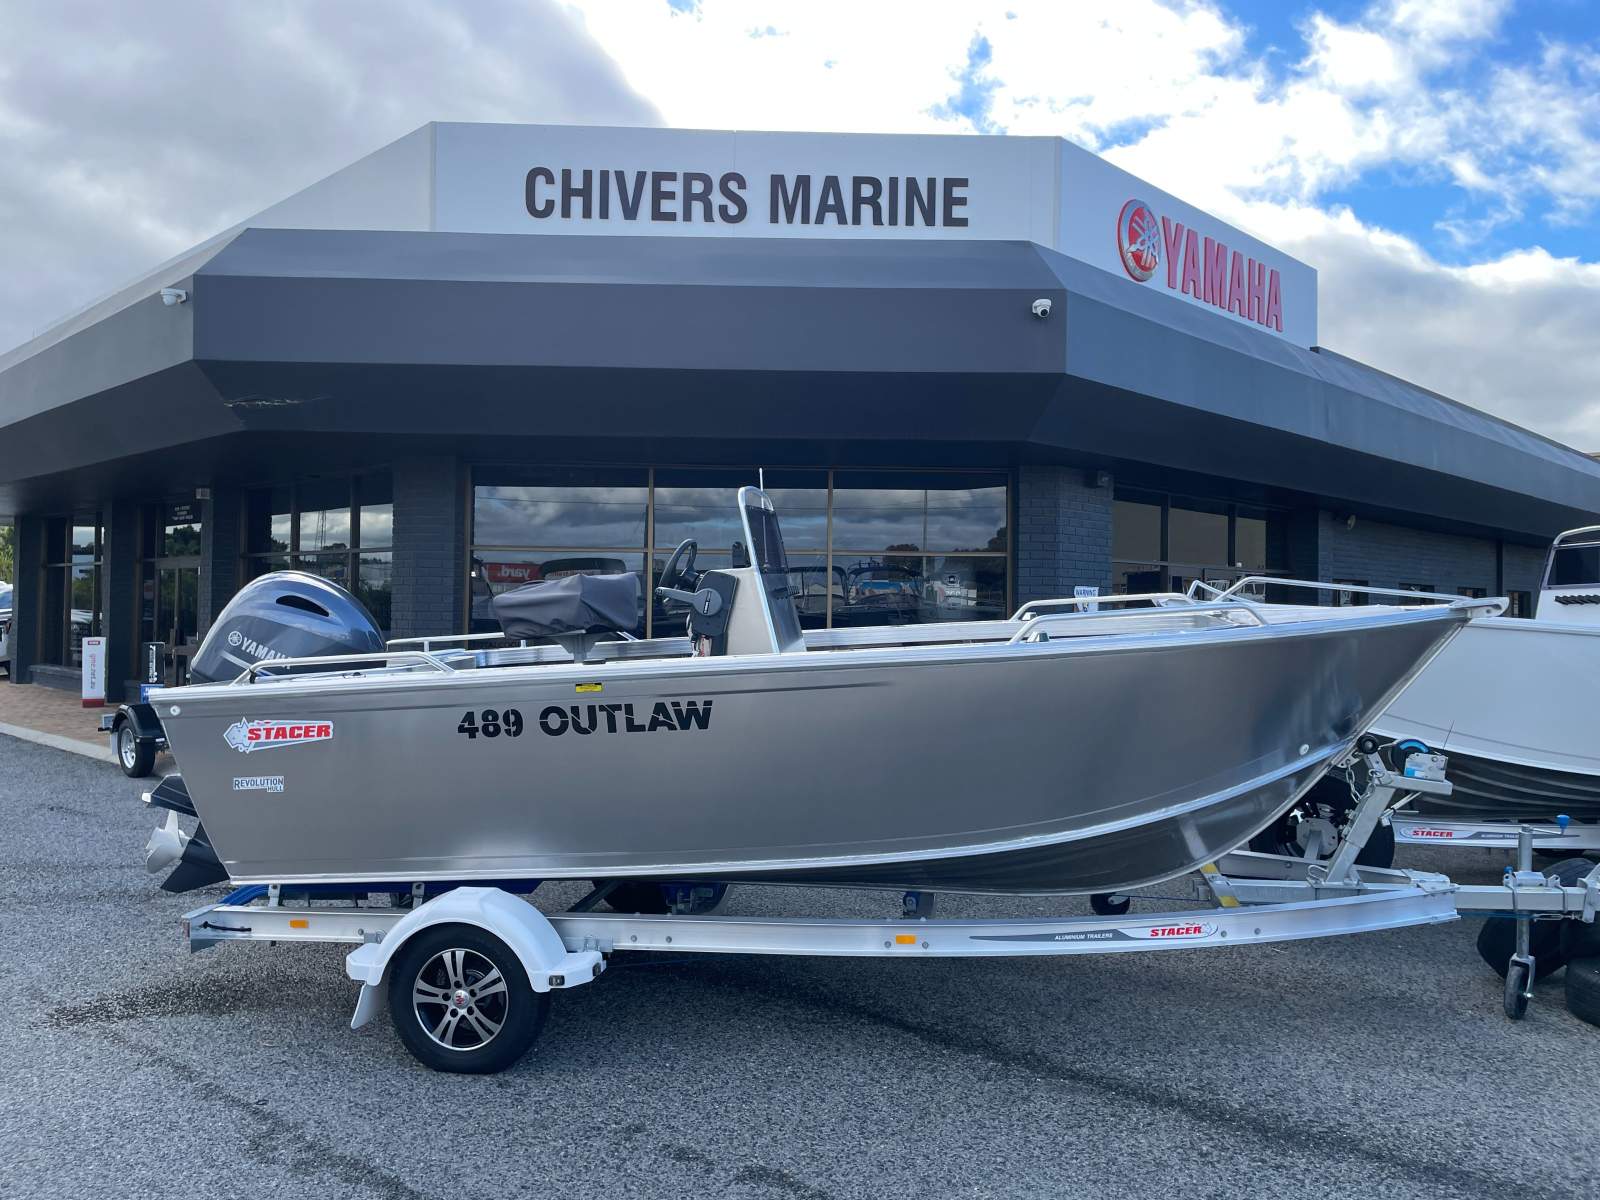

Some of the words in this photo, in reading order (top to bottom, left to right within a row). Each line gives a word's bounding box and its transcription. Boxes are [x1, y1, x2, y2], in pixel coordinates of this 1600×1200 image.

[525, 166, 748, 224] CHIVERS
[769, 174, 969, 227] MARINE
[1161, 215, 1283, 333] YAMAHA
[457, 709, 524, 739] 489
[539, 700, 713, 737] OUTLAW
[247, 724, 331, 741] STACER
[233, 777, 284, 789] REVOLUTION
[1412, 829, 1453, 838] STACER
[1150, 925, 1202, 937] STACER
